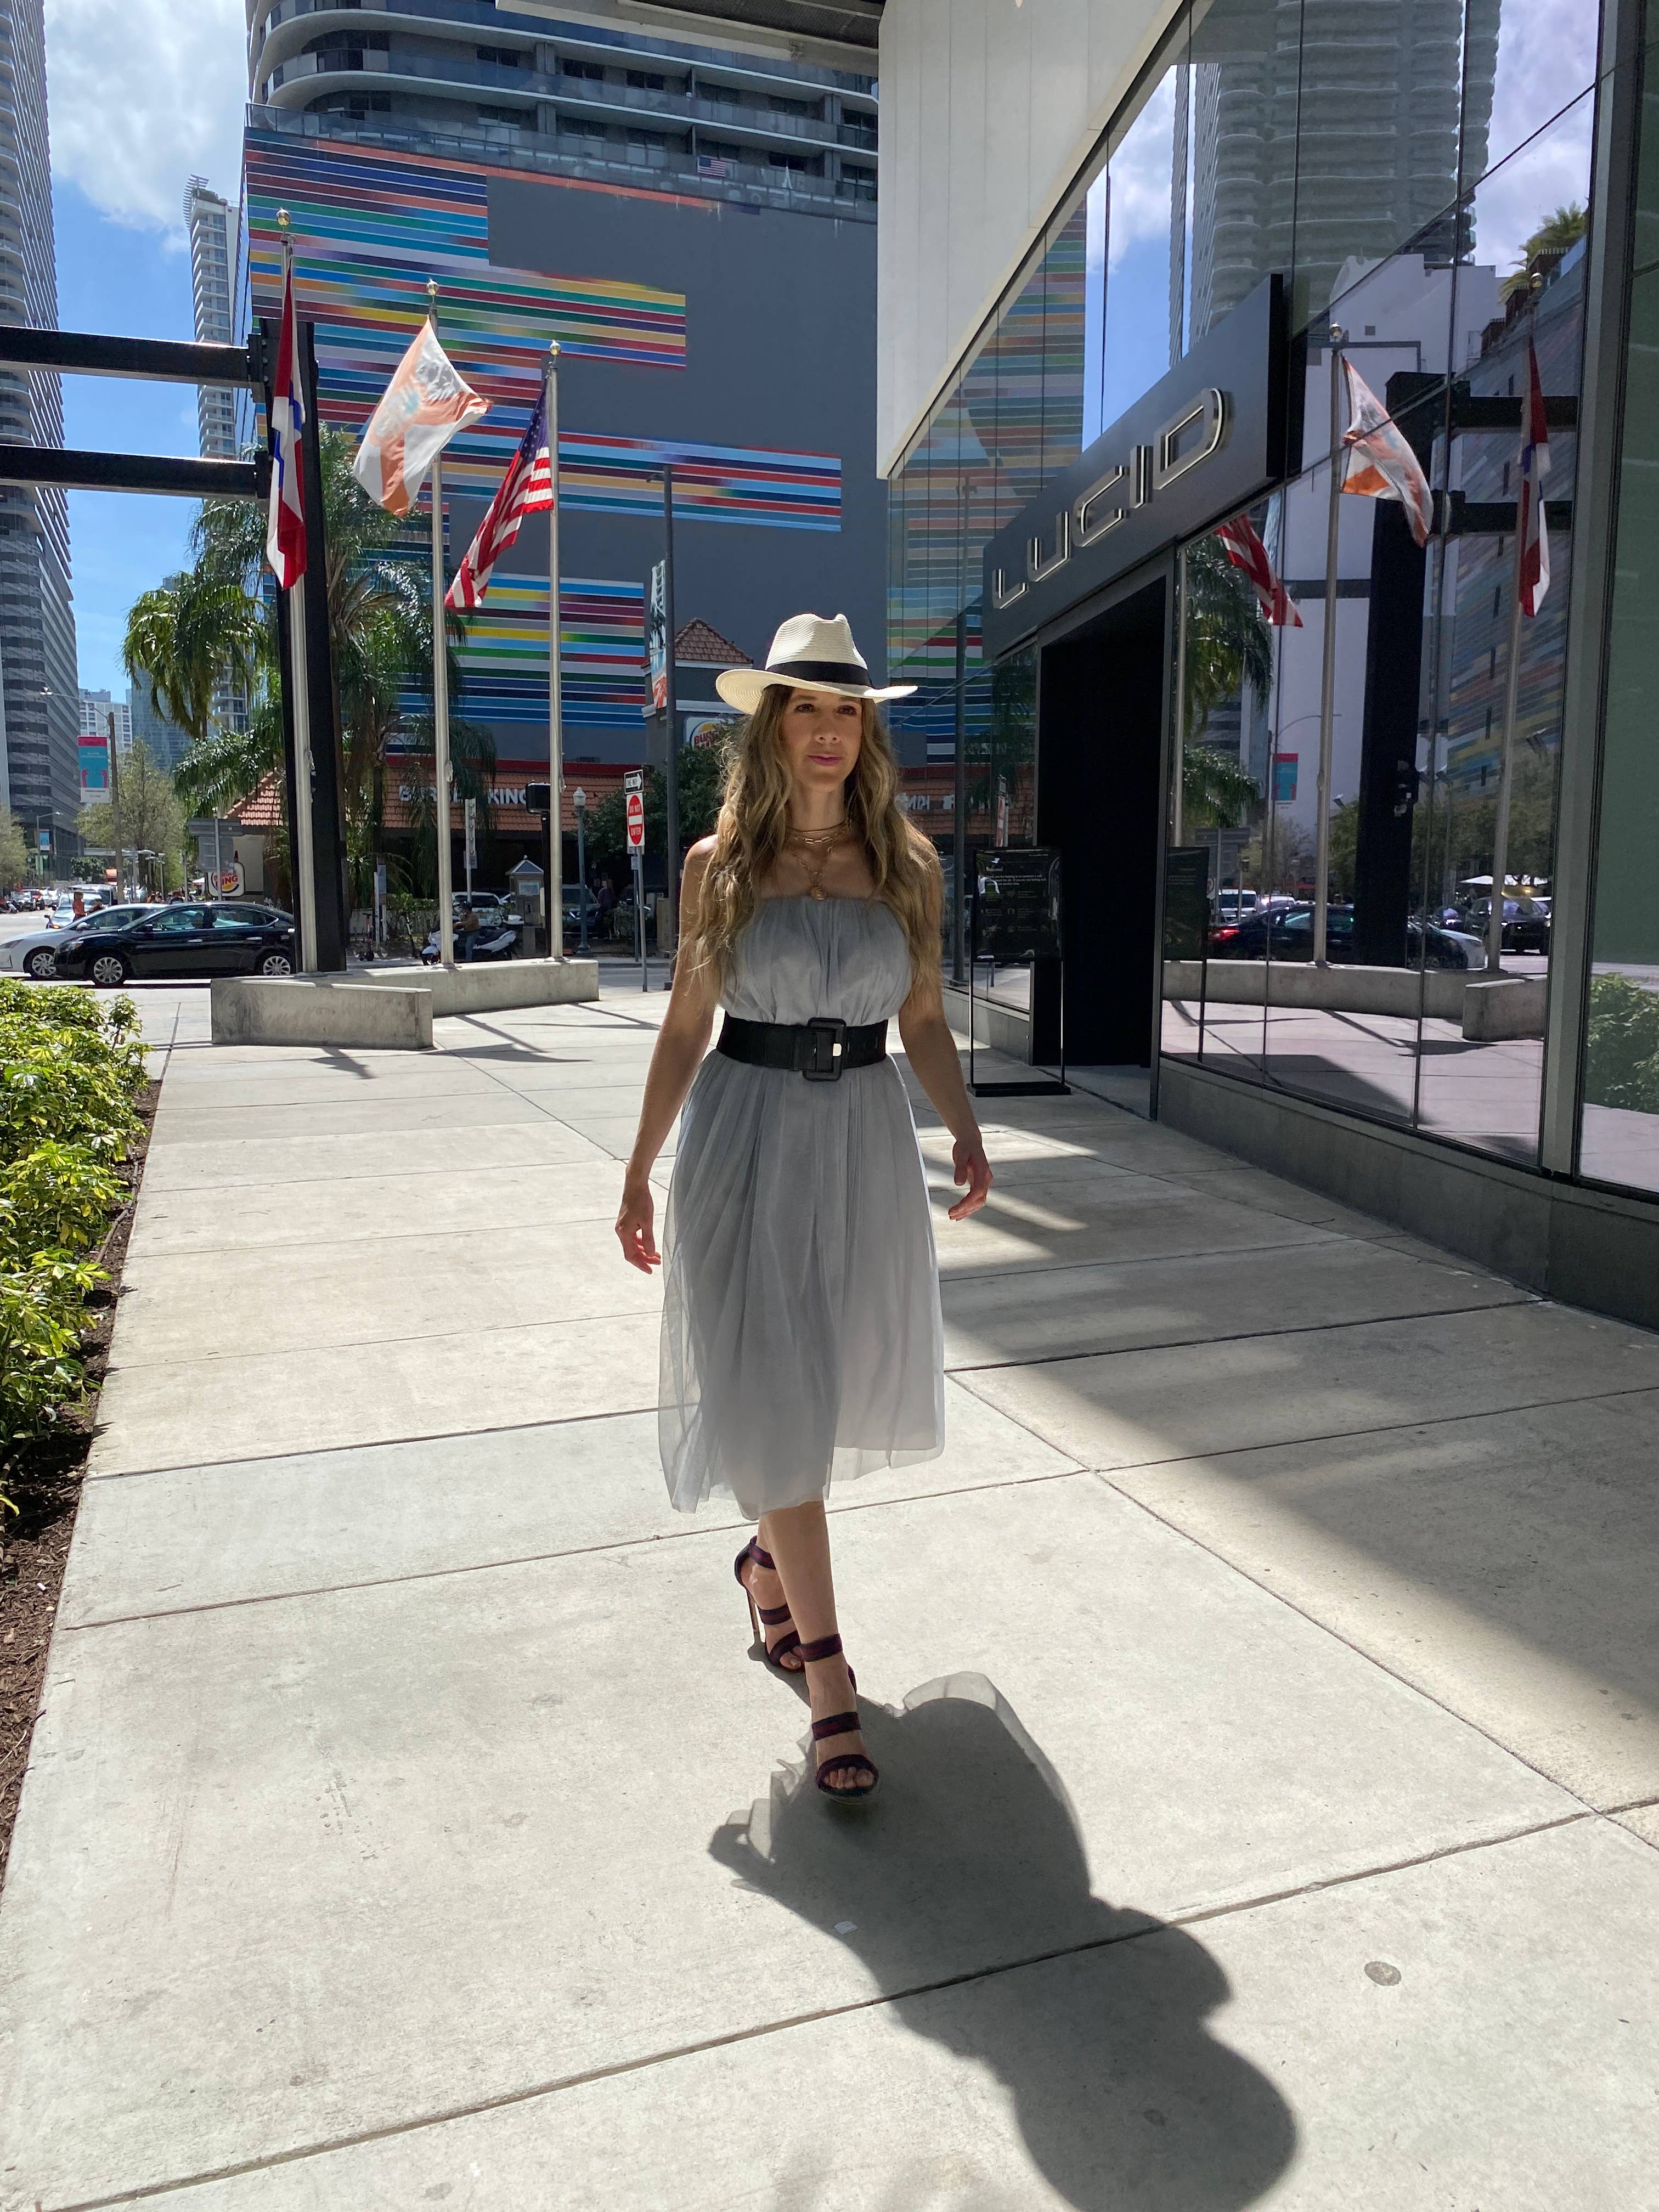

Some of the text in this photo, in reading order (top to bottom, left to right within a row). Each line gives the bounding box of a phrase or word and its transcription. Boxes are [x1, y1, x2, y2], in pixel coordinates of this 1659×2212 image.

[992, 387, 1227, 610] LUCID
[629, 805, 634, 814] DO
[630, 826, 641, 836] ENTER
